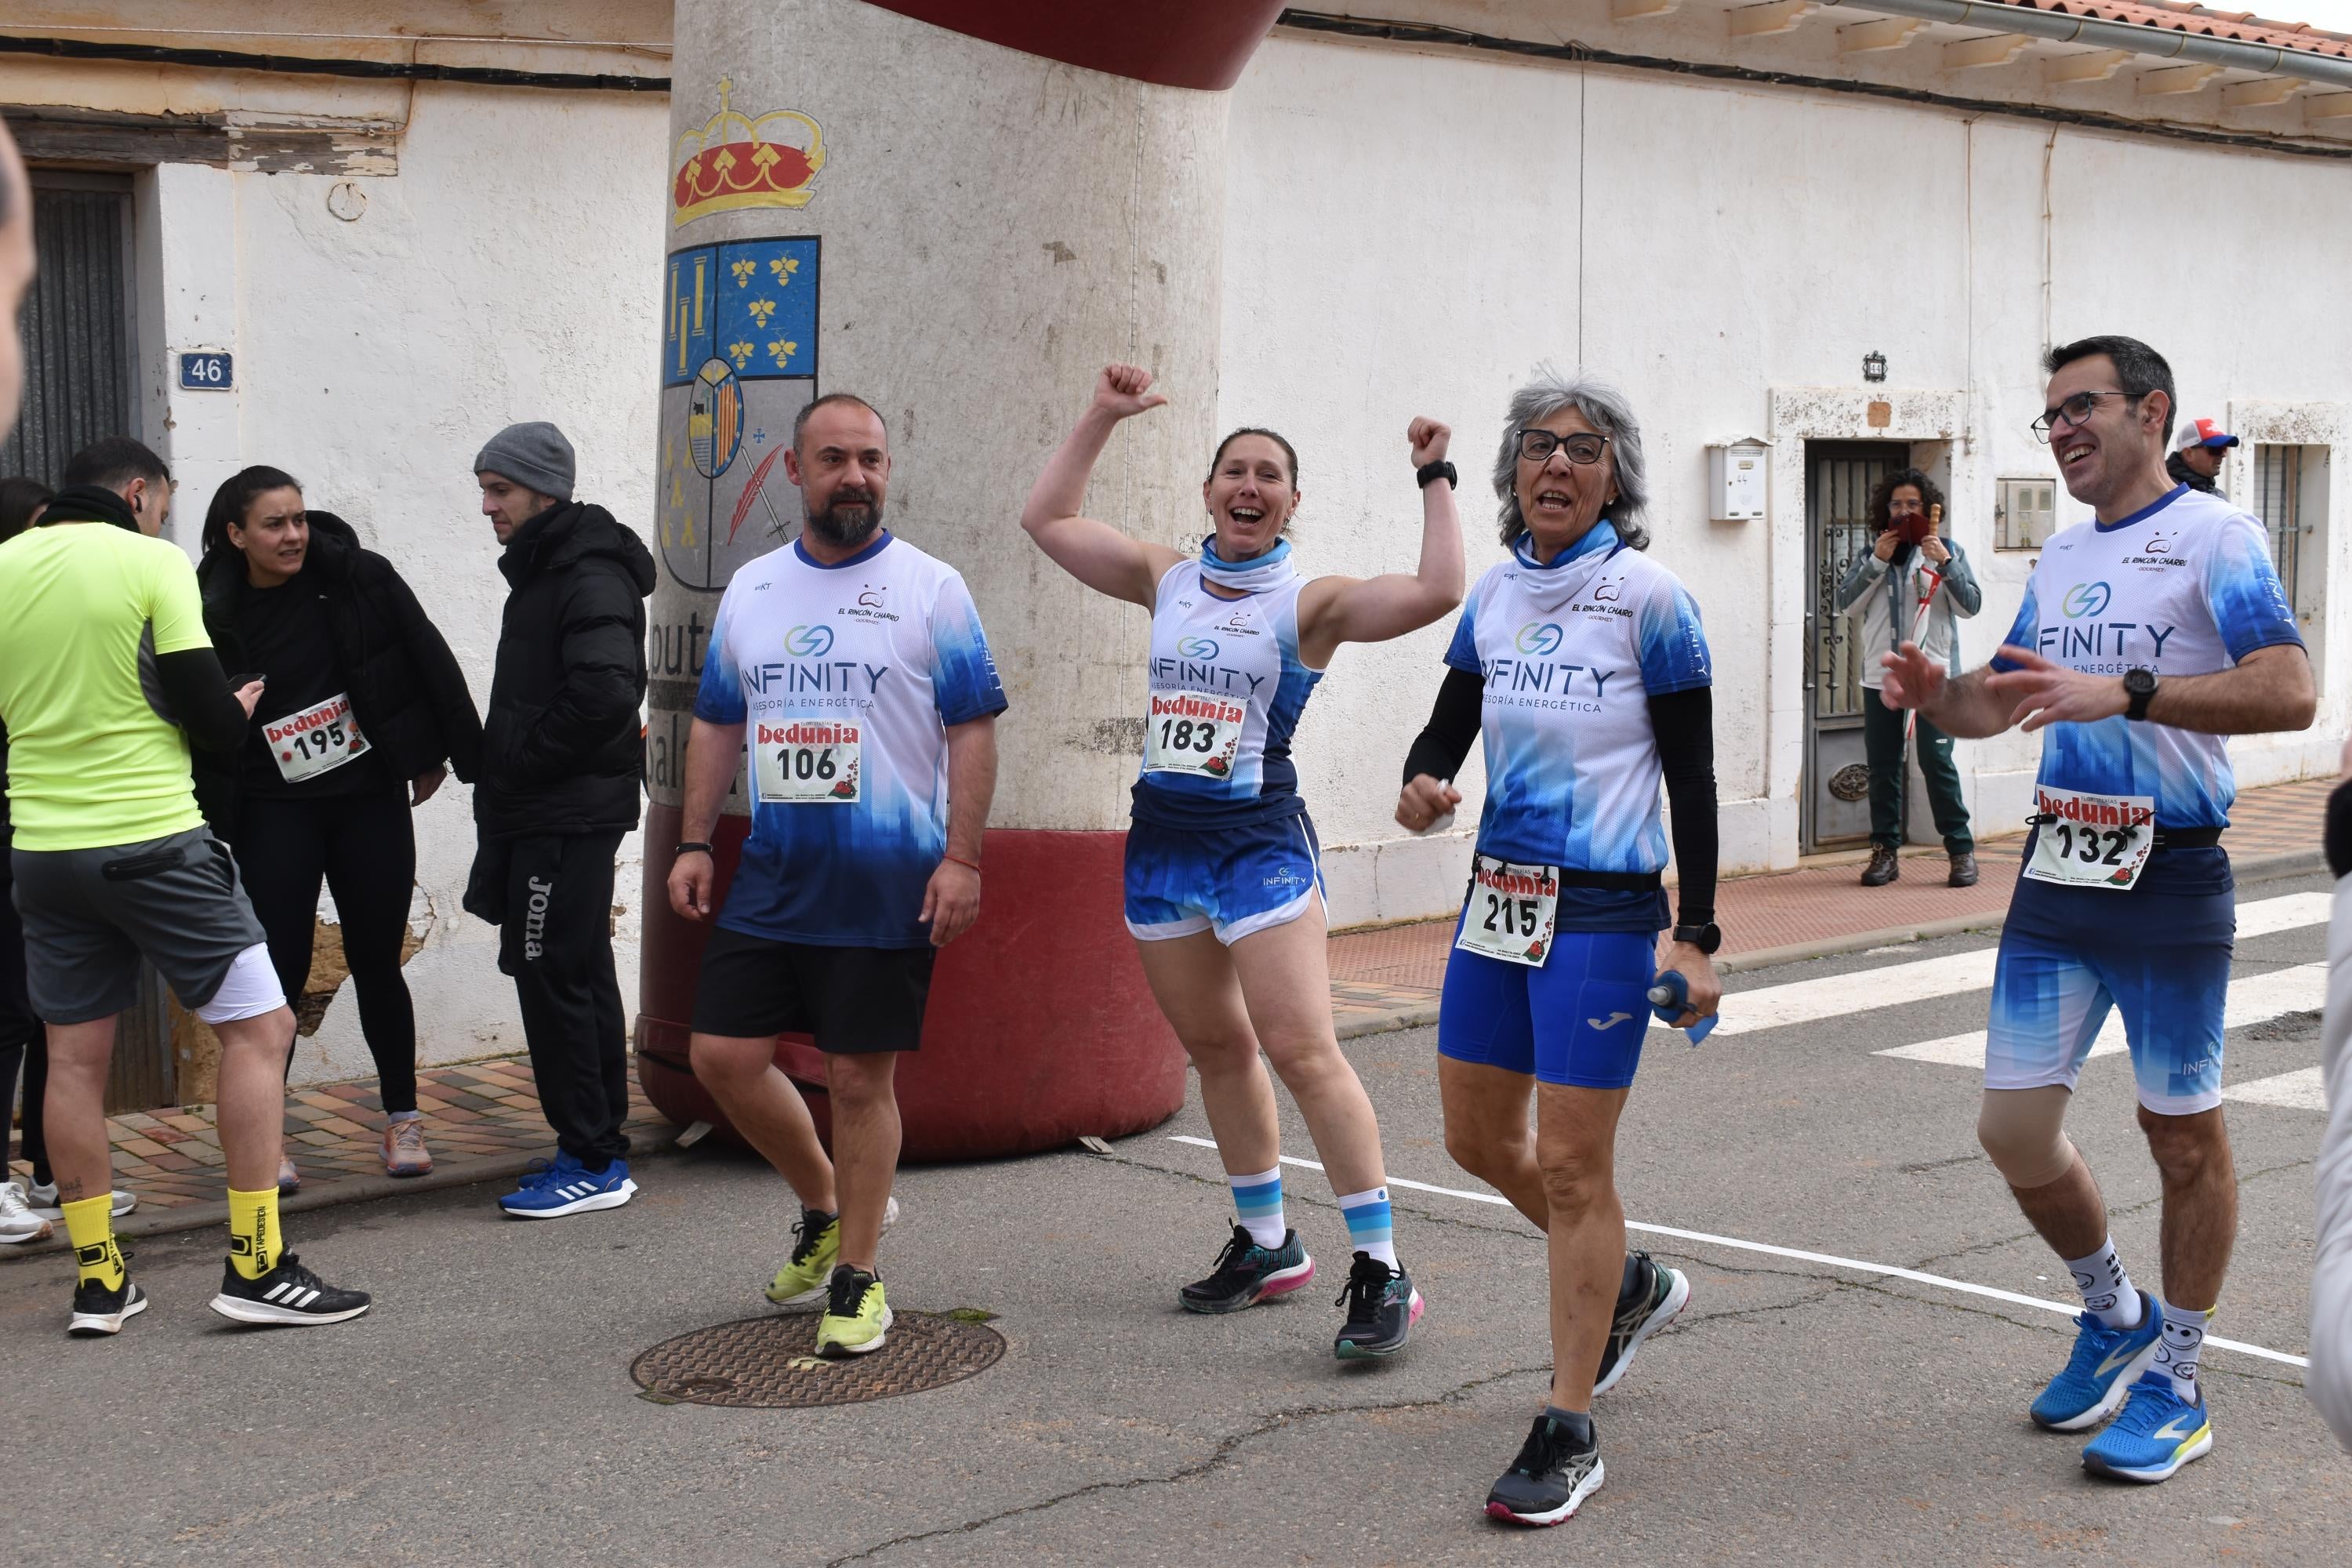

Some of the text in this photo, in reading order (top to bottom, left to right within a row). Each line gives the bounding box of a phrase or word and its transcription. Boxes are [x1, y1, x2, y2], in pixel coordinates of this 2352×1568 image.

[192, 358, 222, 382] 46
[848, 608, 873, 617] RINCÓN
[873, 612, 900, 622] CHARRO
[1582, 604, 1606, 612] RINCÓN
[2034, 622, 2176, 658] FINITY
[1149, 657, 1265, 695] NFINITY
[1481, 659, 1617, 698] NFINITY
[753, 695, 875, 711] ASESORÍA ENERGÉTICA
[1152, 695, 1243, 724] bedunia
[1483, 692, 1602, 713] SESORÍA ENERGÉTICA
[266, 699, 350, 744] bedunia
[757, 723, 858, 745] bedunia
[1161, 719, 1216, 753] 183
[293, 720, 346, 760] 195
[777, 748, 837, 780] 106
[2038, 789, 2151, 826] bedunia
[2056, 824, 2127, 866] 132
[1263, 877, 1306, 887] INFINITY
[524, 876, 553, 960] Joma
[1483, 894, 1538, 938] 215
[256, 1206, 267, 1252] TAPEDESIGN
